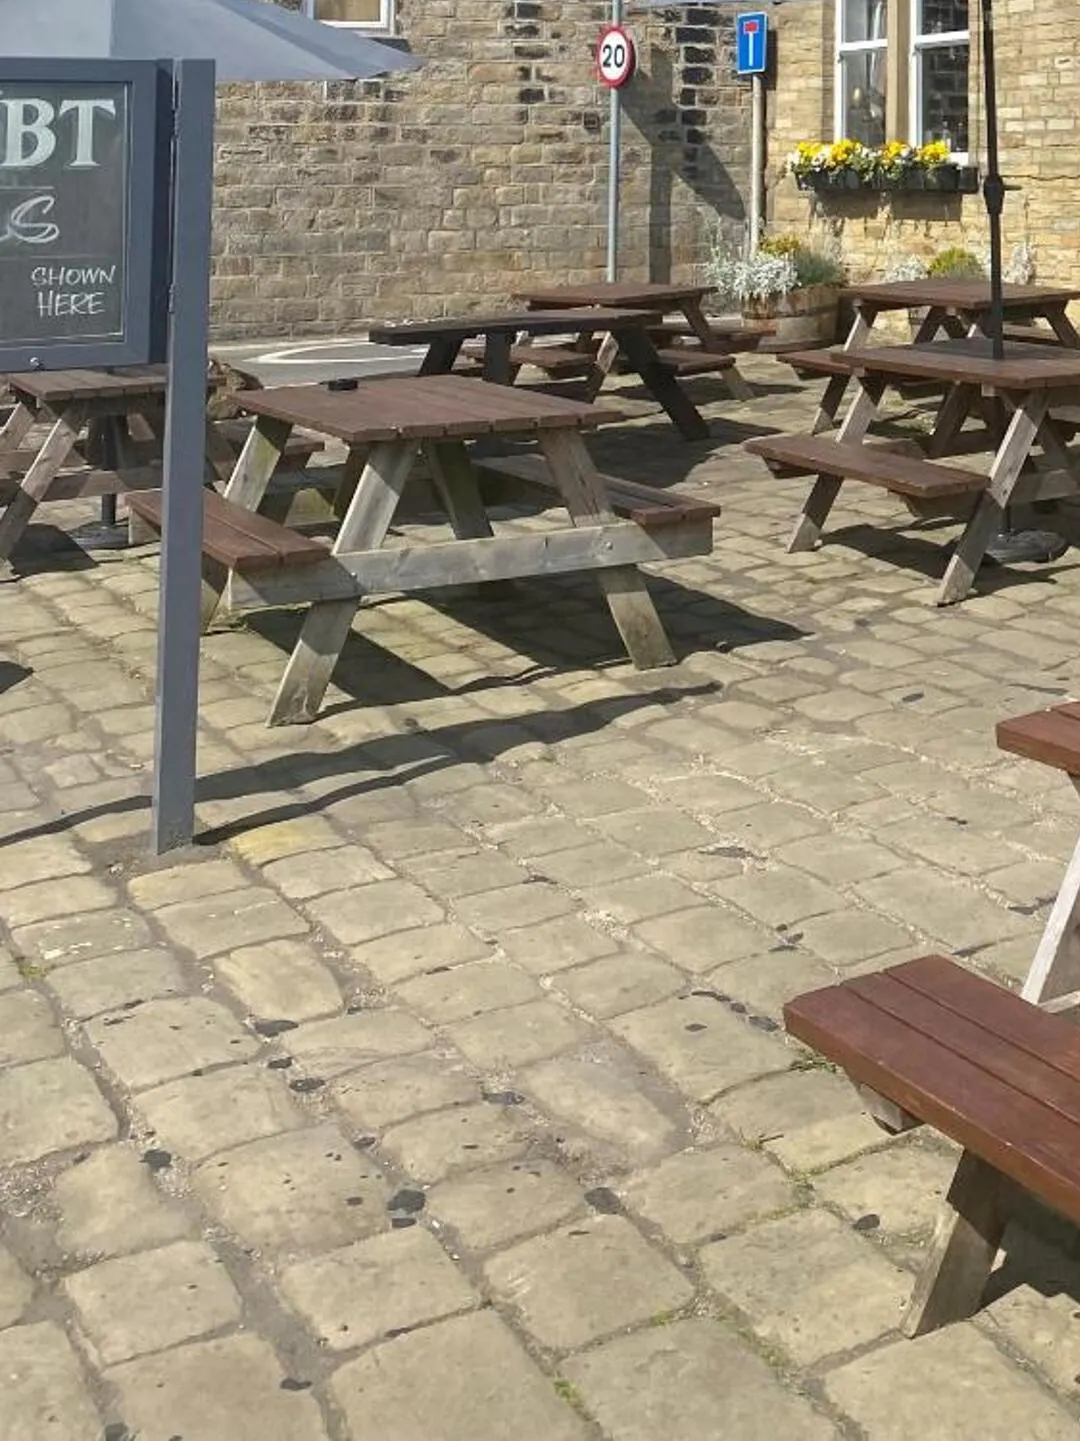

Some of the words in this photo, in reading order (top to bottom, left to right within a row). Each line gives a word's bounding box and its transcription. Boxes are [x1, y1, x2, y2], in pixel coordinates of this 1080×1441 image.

[603, 44, 625, 68] 20
[31, 265, 116, 286] SHOWN
[37, 290, 105, 318] HERE
